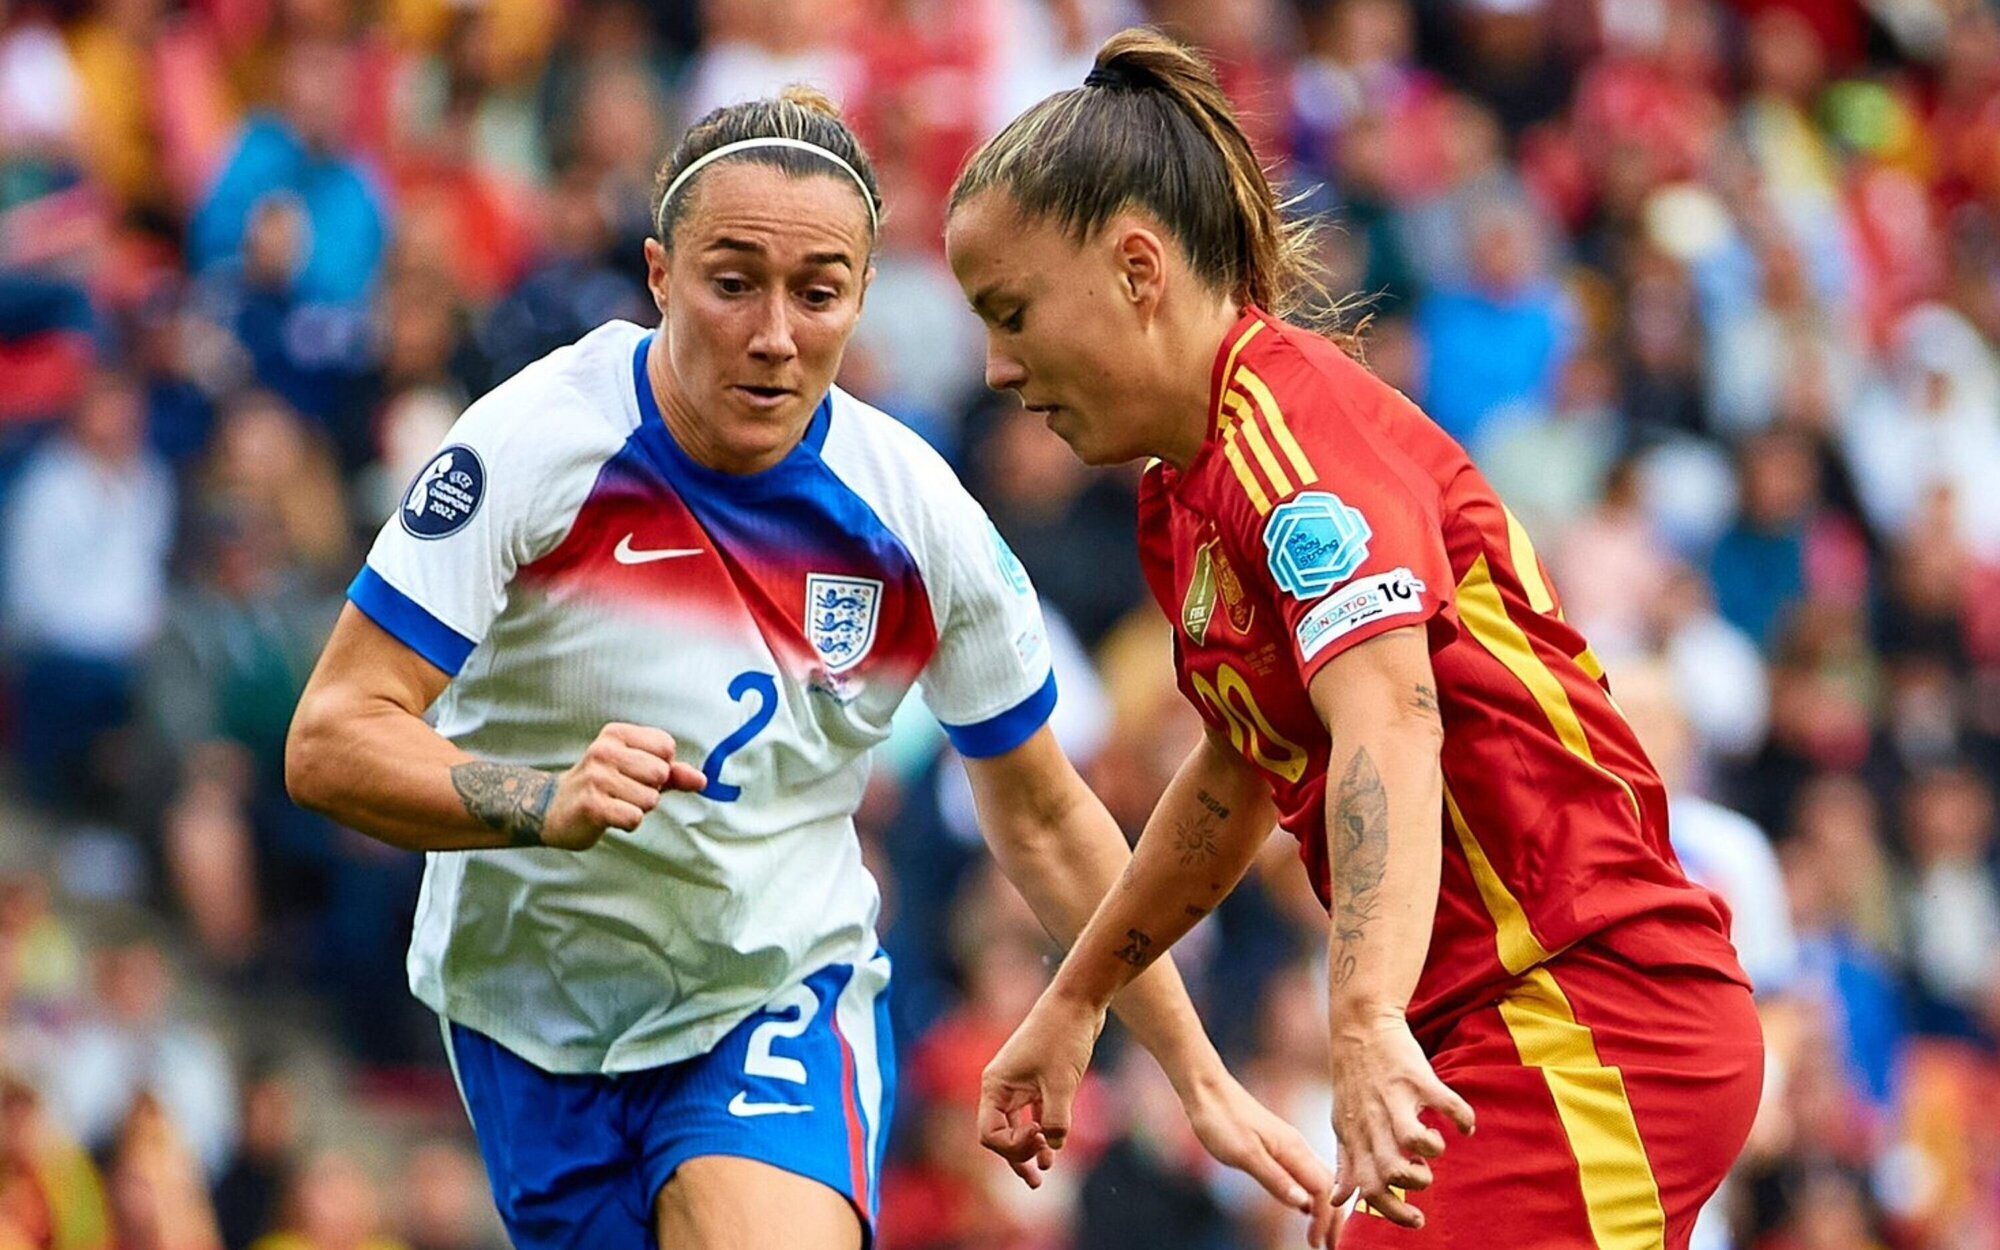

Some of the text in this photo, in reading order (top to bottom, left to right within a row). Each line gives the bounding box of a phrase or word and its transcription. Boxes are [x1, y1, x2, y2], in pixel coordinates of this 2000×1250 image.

[429, 501, 456, 520] 2022
[699, 670, 779, 803] 2
[743, 980, 820, 1086] 2
